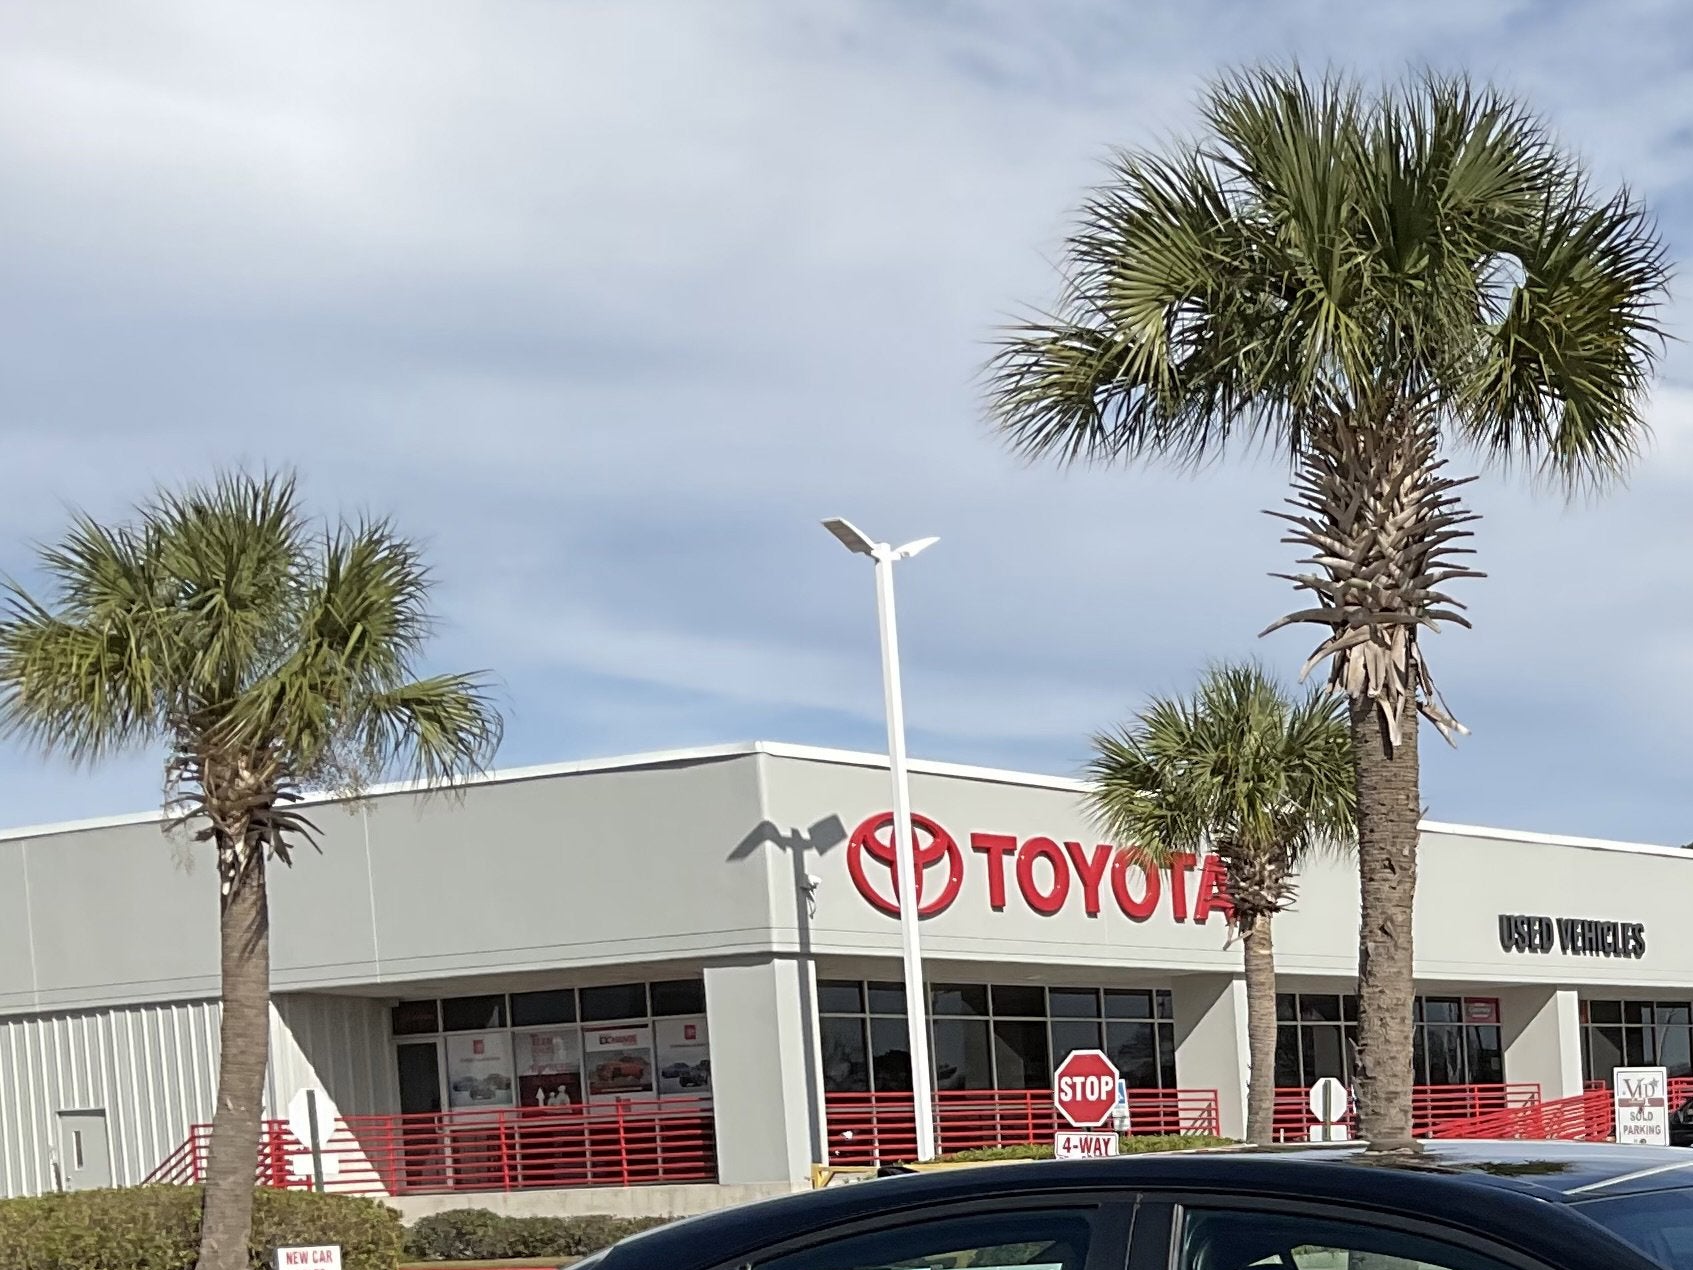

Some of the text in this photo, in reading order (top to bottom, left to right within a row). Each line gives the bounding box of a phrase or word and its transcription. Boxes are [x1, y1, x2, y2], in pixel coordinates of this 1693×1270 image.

[970, 832, 1238, 925] TOYOTA
[1498, 914, 1646, 959] USED VEHICLES
[1060, 1075, 1114, 1102] STOP
[1630, 1112, 1653, 1121] SOLD
[1623, 1125, 1661, 1135] PARKING
[1062, 1136, 1112, 1156] 4-WAY
[286, 1250, 333, 1265] NEW CAR
